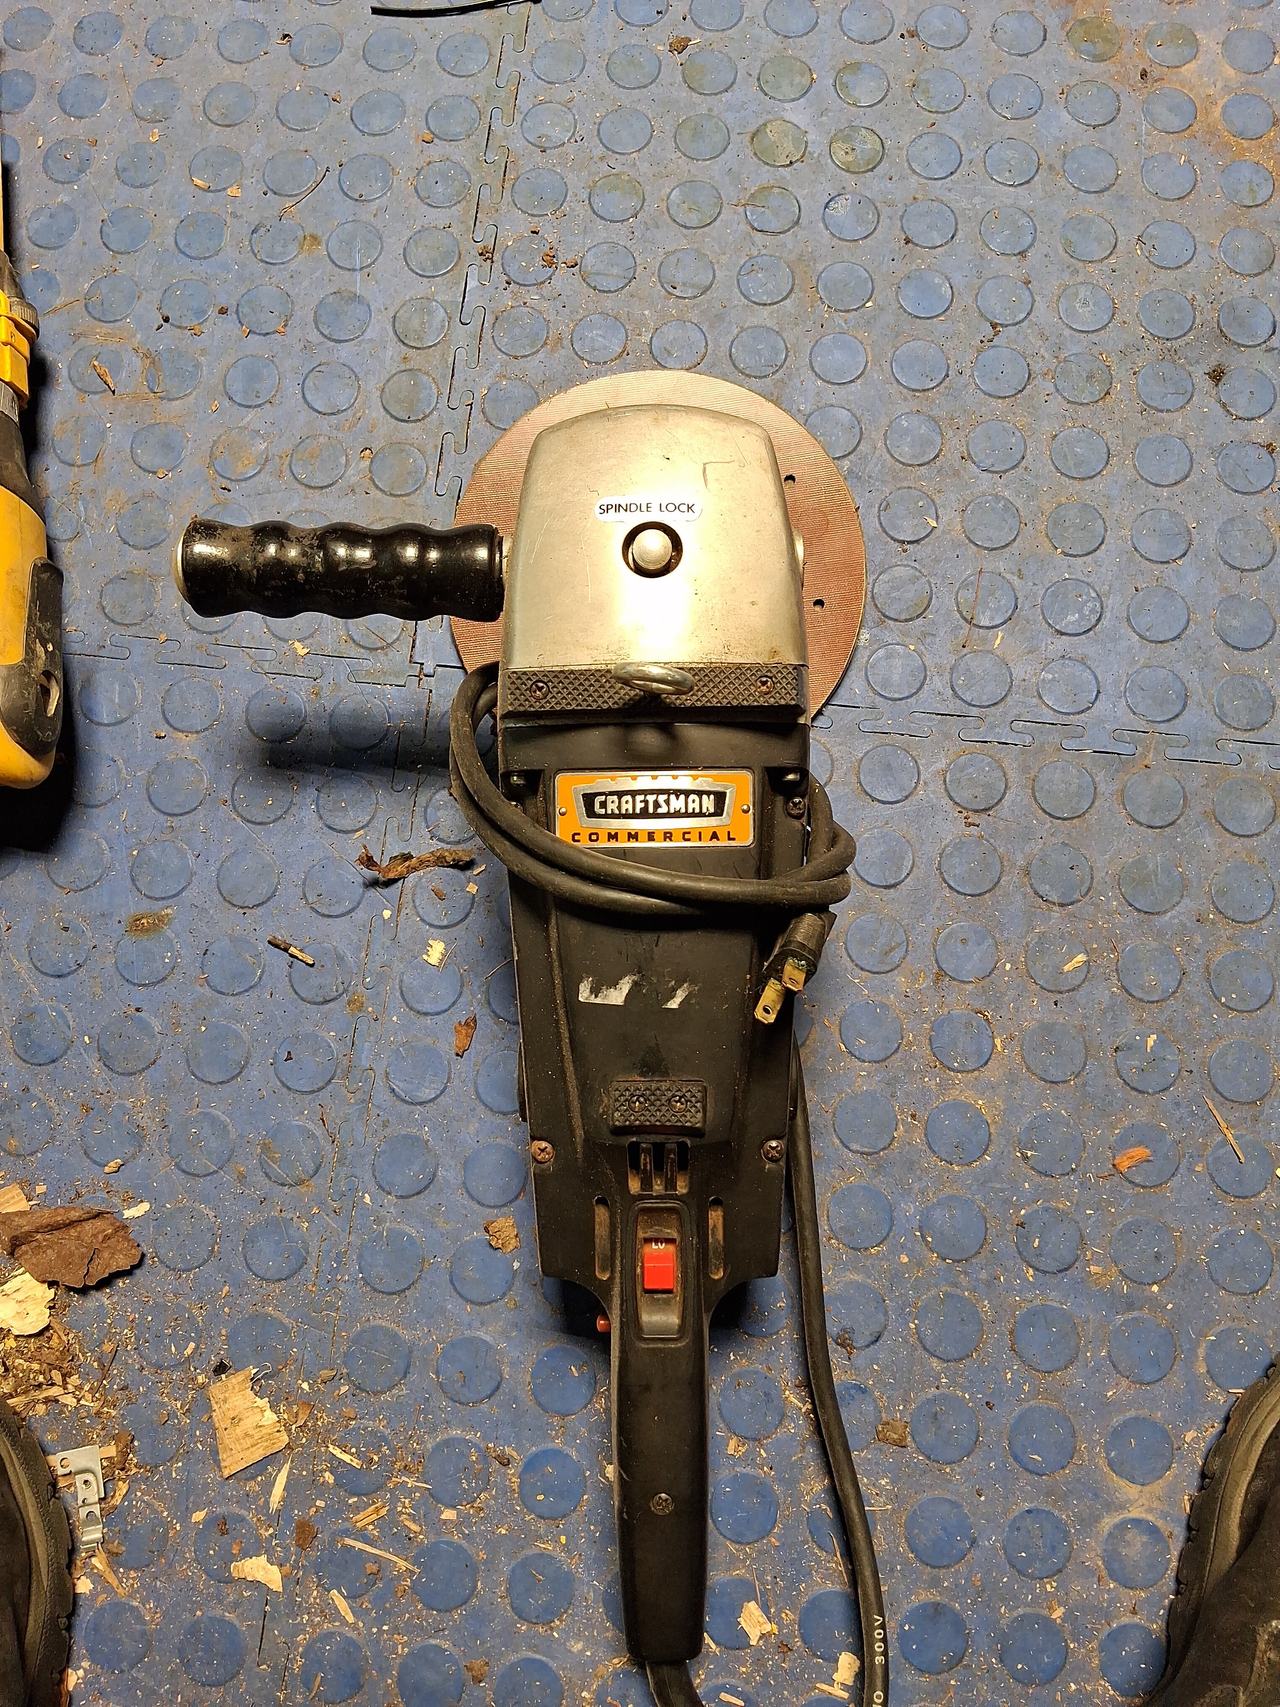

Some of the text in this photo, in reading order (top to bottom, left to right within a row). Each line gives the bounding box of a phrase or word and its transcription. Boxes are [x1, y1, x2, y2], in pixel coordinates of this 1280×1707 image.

[598, 502, 695, 514] SPINDLE LOCK
[594, 793, 715, 815] CRAFTSMAN
[571, 831, 736, 843] COMMERCIAL
[873, 1614, 885, 1665] 300V
